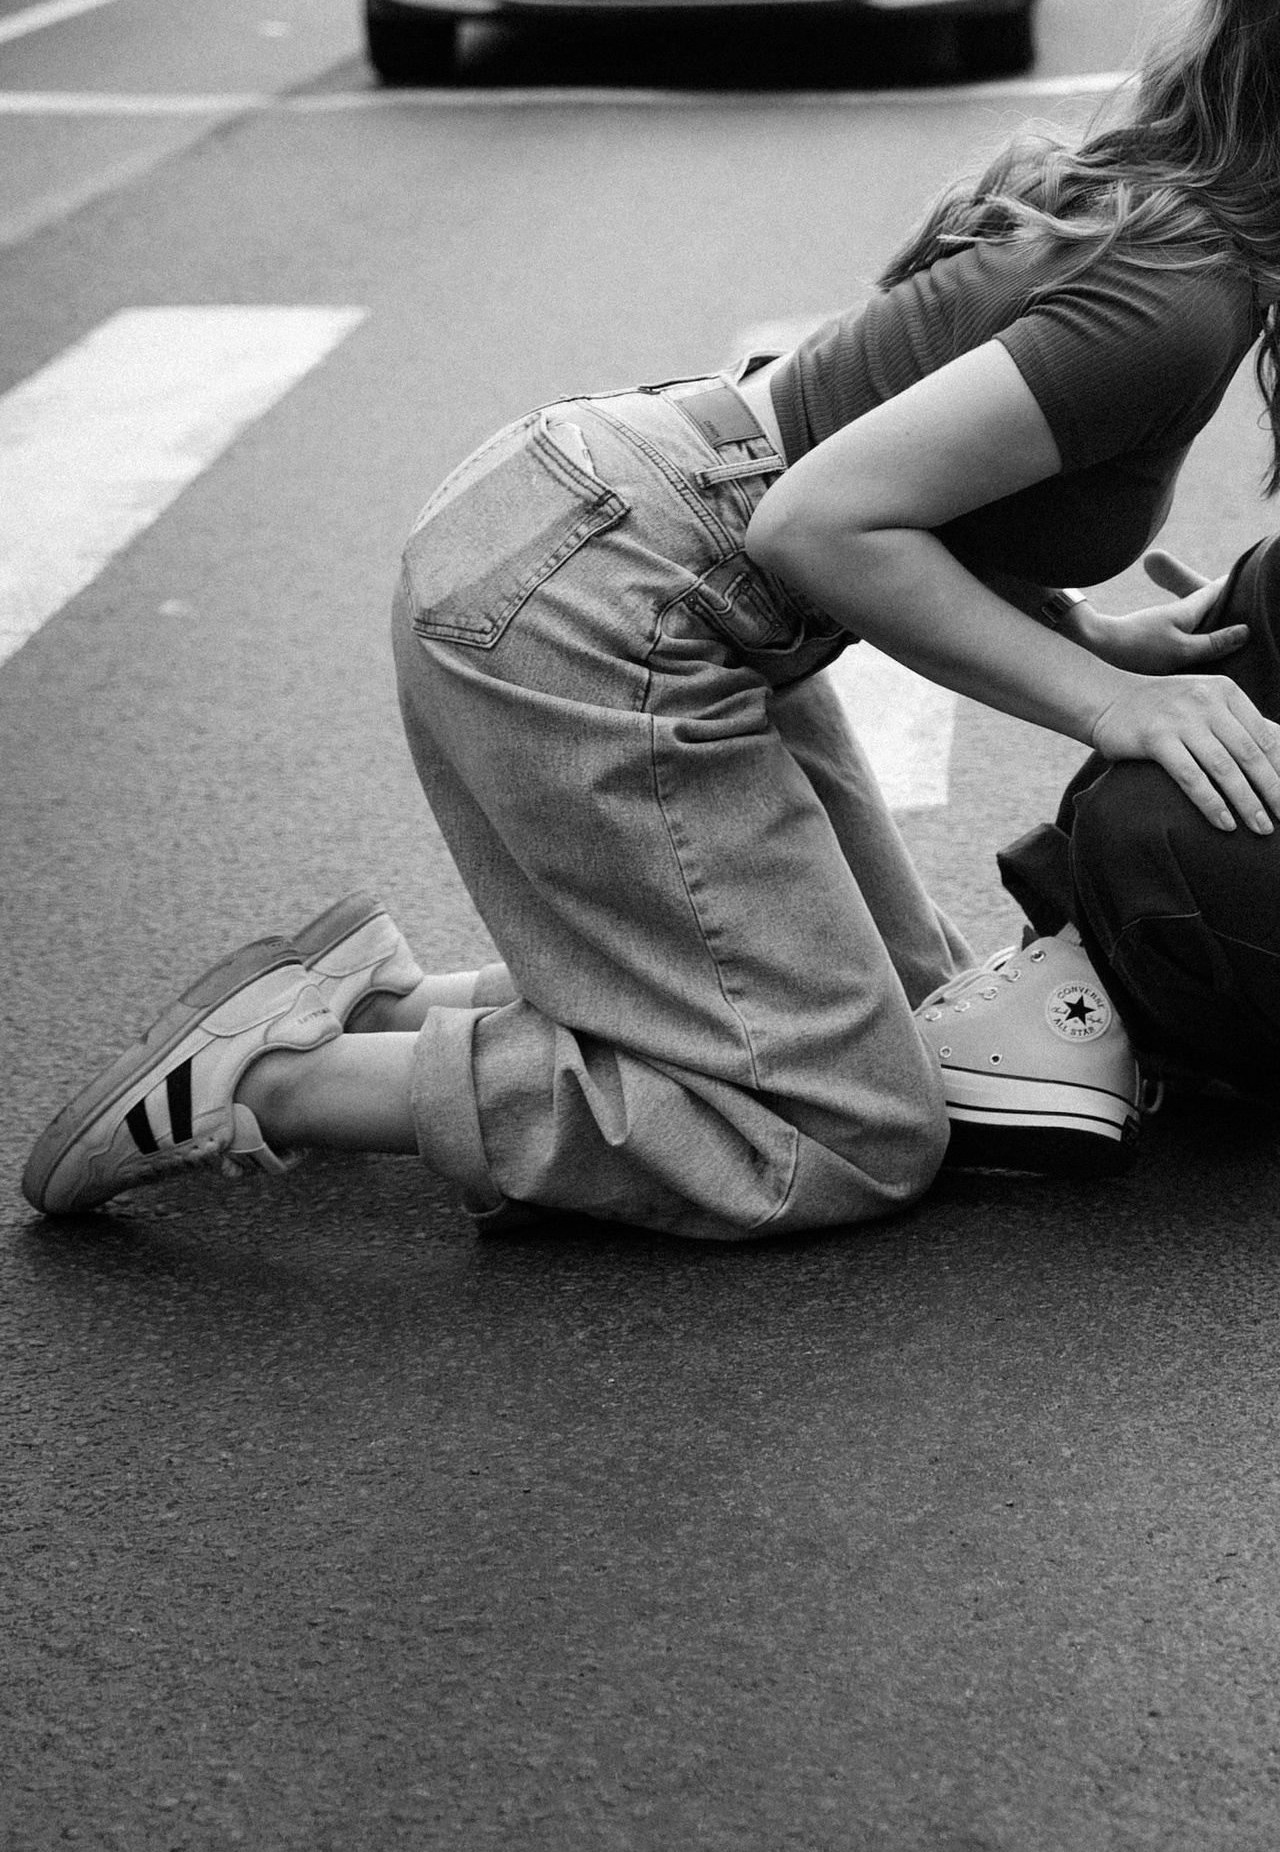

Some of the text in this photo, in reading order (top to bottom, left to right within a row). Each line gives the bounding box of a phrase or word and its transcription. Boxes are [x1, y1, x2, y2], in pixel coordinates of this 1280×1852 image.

[1058, 986, 1105, 1008] CONVERSE
[1052, 1018, 1095, 1036] ALL STAR
